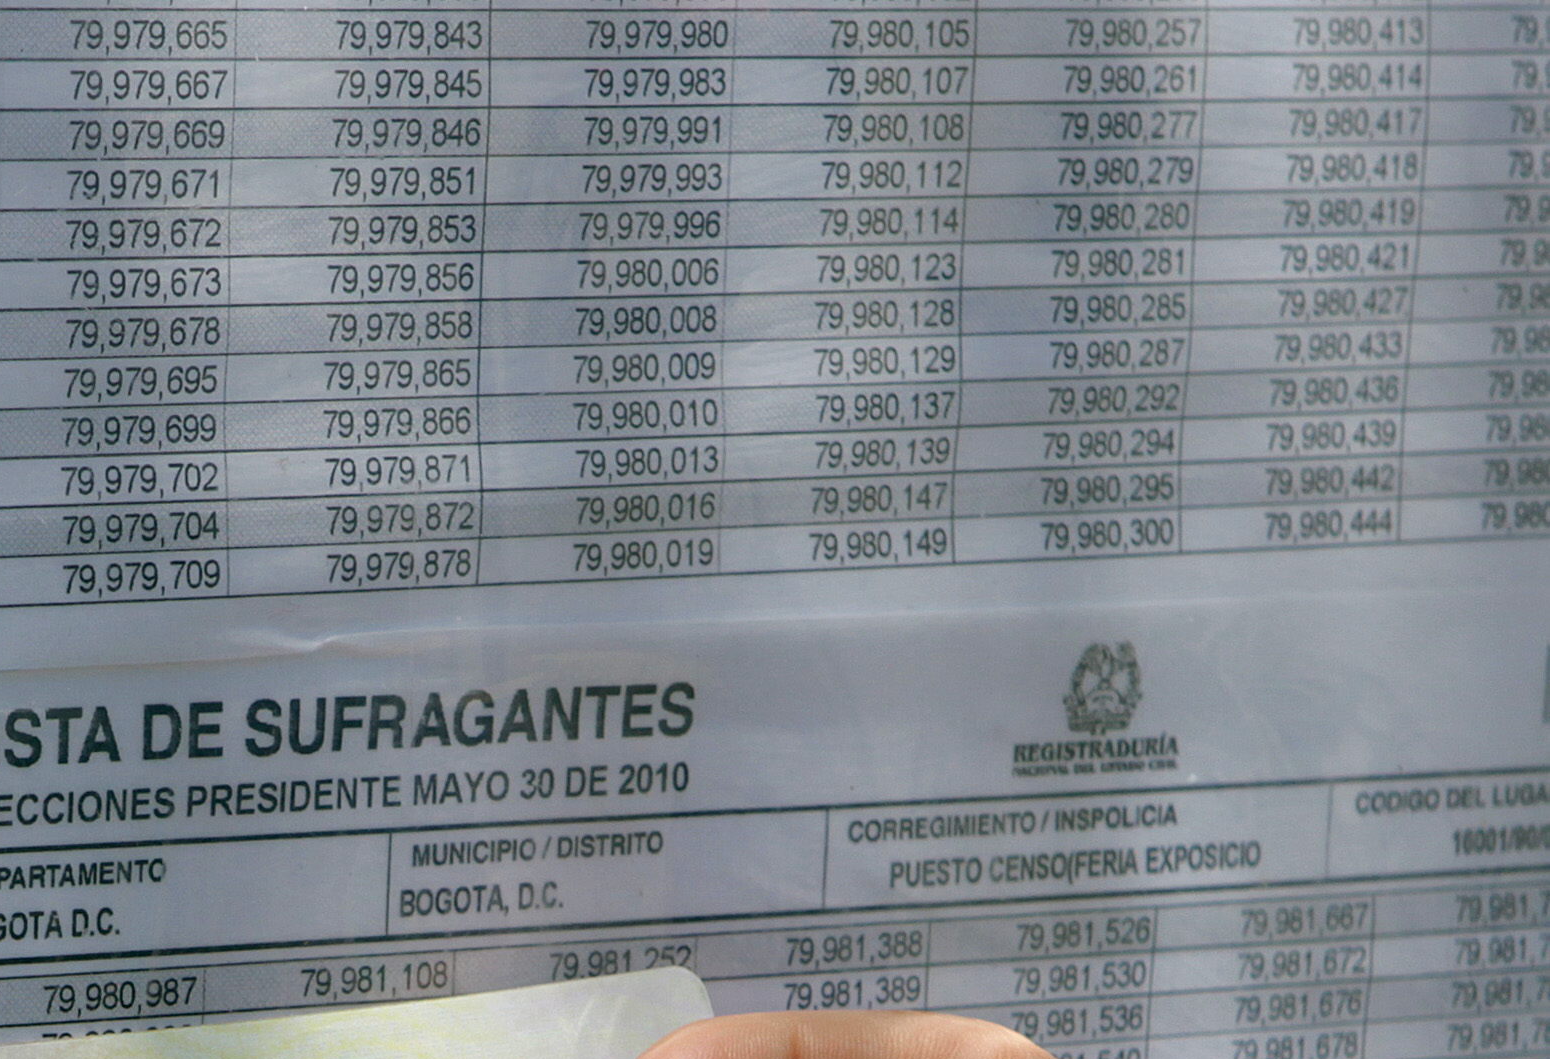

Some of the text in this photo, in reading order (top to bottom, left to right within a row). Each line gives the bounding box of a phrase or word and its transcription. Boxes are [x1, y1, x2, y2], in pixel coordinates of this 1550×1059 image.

[70, 20, 227, 56] 79,979,665
[336, 20, 482, 55] 79,979,843
[586, 20, 728, 53] 79,979,980
[830, 19, 969, 53] 79,980,105
[1066, 17, 1201, 47] 79,980,257
[69, 119, 225, 155] 79,979,669
[332, 118, 481, 153] 79,979,846
[584, 116, 721, 149] 79,979,991
[822, 160, 962, 194] 79,980,112
[1058, 156, 1194, 190] 79,980,279
[328, 214, 476, 250] 79,979,853
[579, 210, 721, 245] 79,979,996
[67, 267, 222, 303] 79,979,673
[817, 253, 956, 287] 79,980,123
[327, 311, 473, 347] 79,979,858
[574, 352, 715, 387] 79,980,009
[814, 345, 956, 380] 79,980,129
[1050, 338, 1185, 371] 79,980,287
[64, 365, 217, 402] 79,979,695
[323, 406, 471, 443] 79,979,866
[61, 462, 218, 499] 79,979,702
[575, 445, 718, 481] 79,980,013
[809, 528, 947, 565] 79,980,149
[1041, 518, 1174, 554] 79,980,300
[327, 549, 471, 586] 79,979,878
[573, 538, 713, 576] 79,980,019
[63, 559, 220, 597] 79,979,709
[143, 701, 223, 760] DE
[245, 682, 695, 757] SUFRAGANTES
[187, 776, 401, 817] PRESIDENTE
[413, 771, 509, 805] MAYO
[522, 769, 554, 799] 30
[565, 765, 607, 797] DE
[619, 762, 689, 795] 2010
[848, 811, 1036, 844] CORREGIMIENTO
[1055, 804, 1177, 831] INSPOLICIA
[412, 838, 536, 867] MUNICIPIO
[557, 836, 663, 858] DISTRITO
[890, 857, 983, 888] PUESTO
[1145, 840, 1262, 872] EXPOSICIO
[400, 881, 563, 917] BOGOTA, D.C.
[72, 907, 120, 937] D.C.
[1017, 916, 1151, 951] 79,981,526
[787, 930, 922, 966] 79,981,388
[43, 976, 197, 1018] 79,980,987
[301, 961, 447, 997] 79,981,108
[784, 975, 921, 1010] 79,981,389
[1014, 961, 1146, 998] 79,981,530
[1011, 1004, 1143, 1042] 79,981,536
